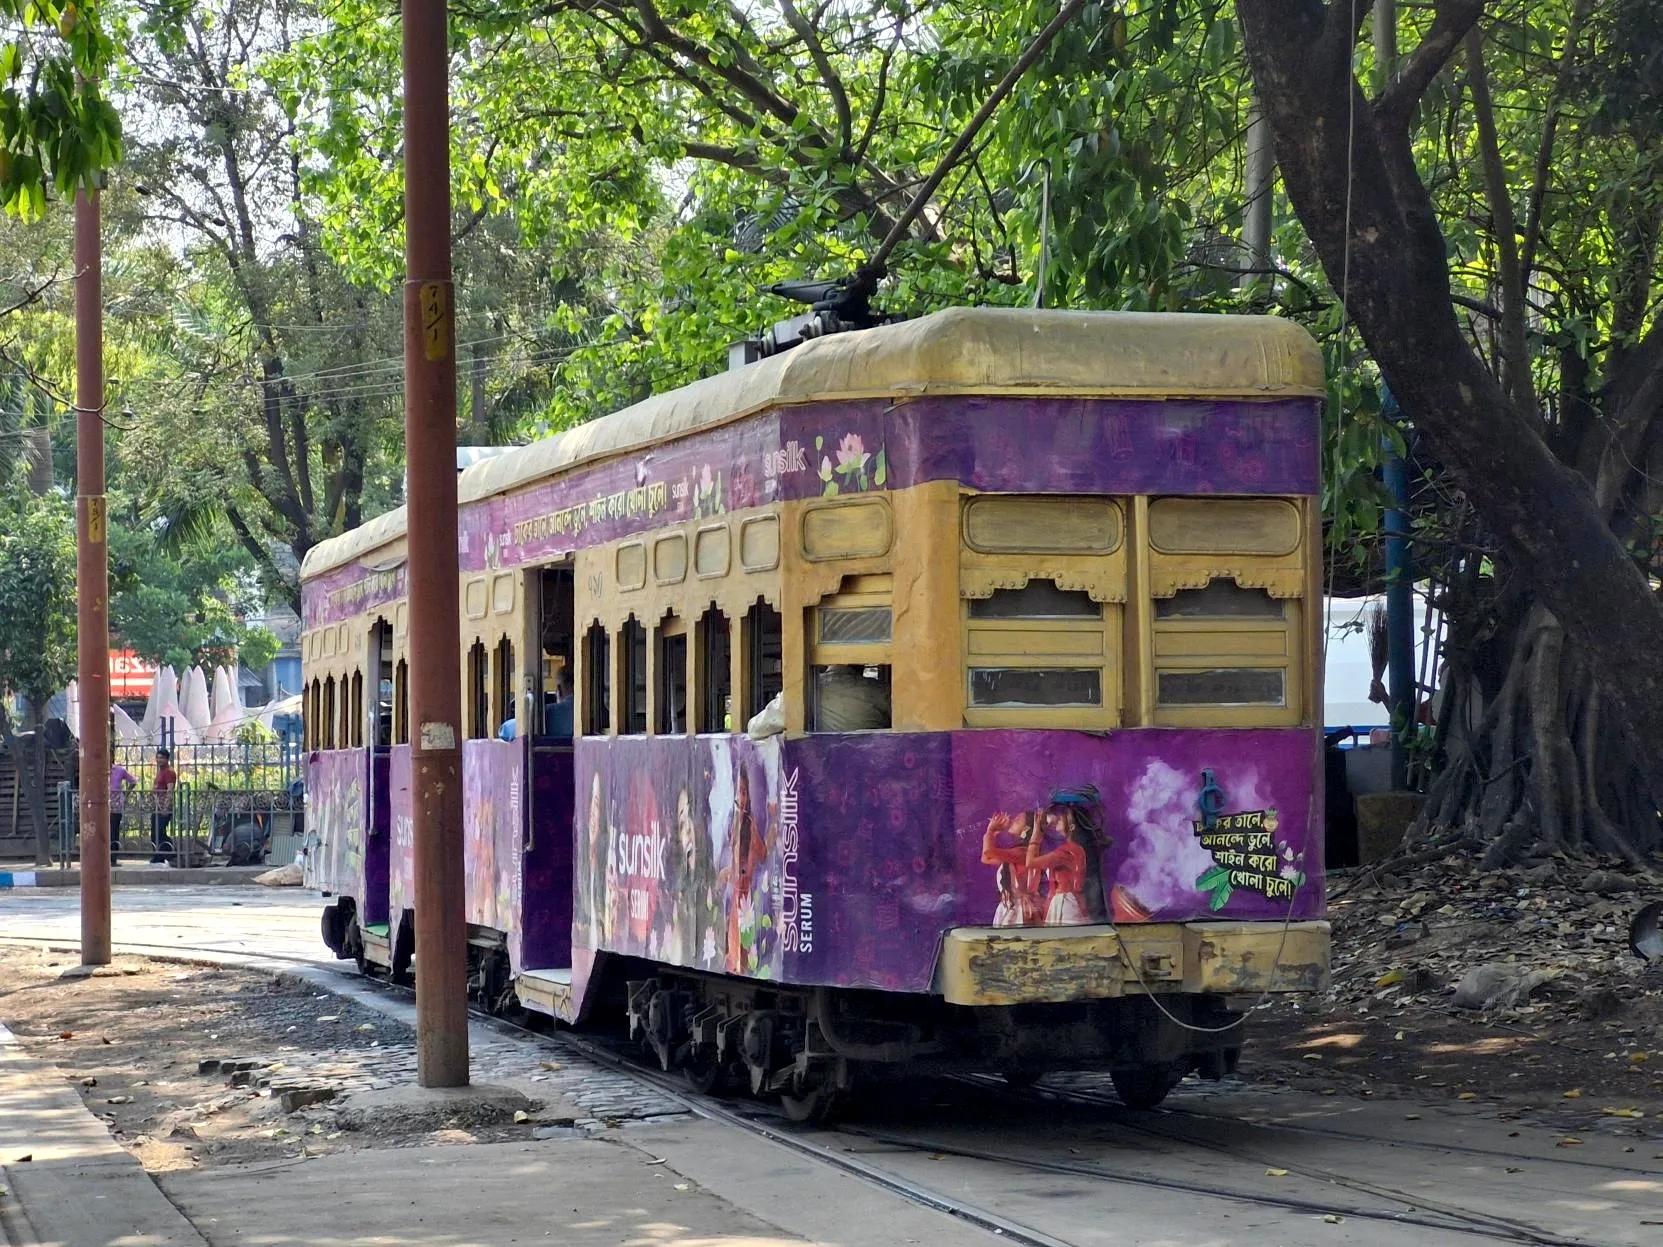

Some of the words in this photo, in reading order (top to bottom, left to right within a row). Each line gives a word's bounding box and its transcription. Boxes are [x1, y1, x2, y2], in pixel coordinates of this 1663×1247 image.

[618, 821, 666, 880] sunsilk
[780, 766, 800, 953] sunsilk
[1201, 833, 1245, 847] আনন্দে
[1214, 849, 1245, 867] শাইন
[1248, 854, 1277, 871] করো
[1231, 870, 1263, 890] খোলা
[800, 893, 812, 953] SERUM
